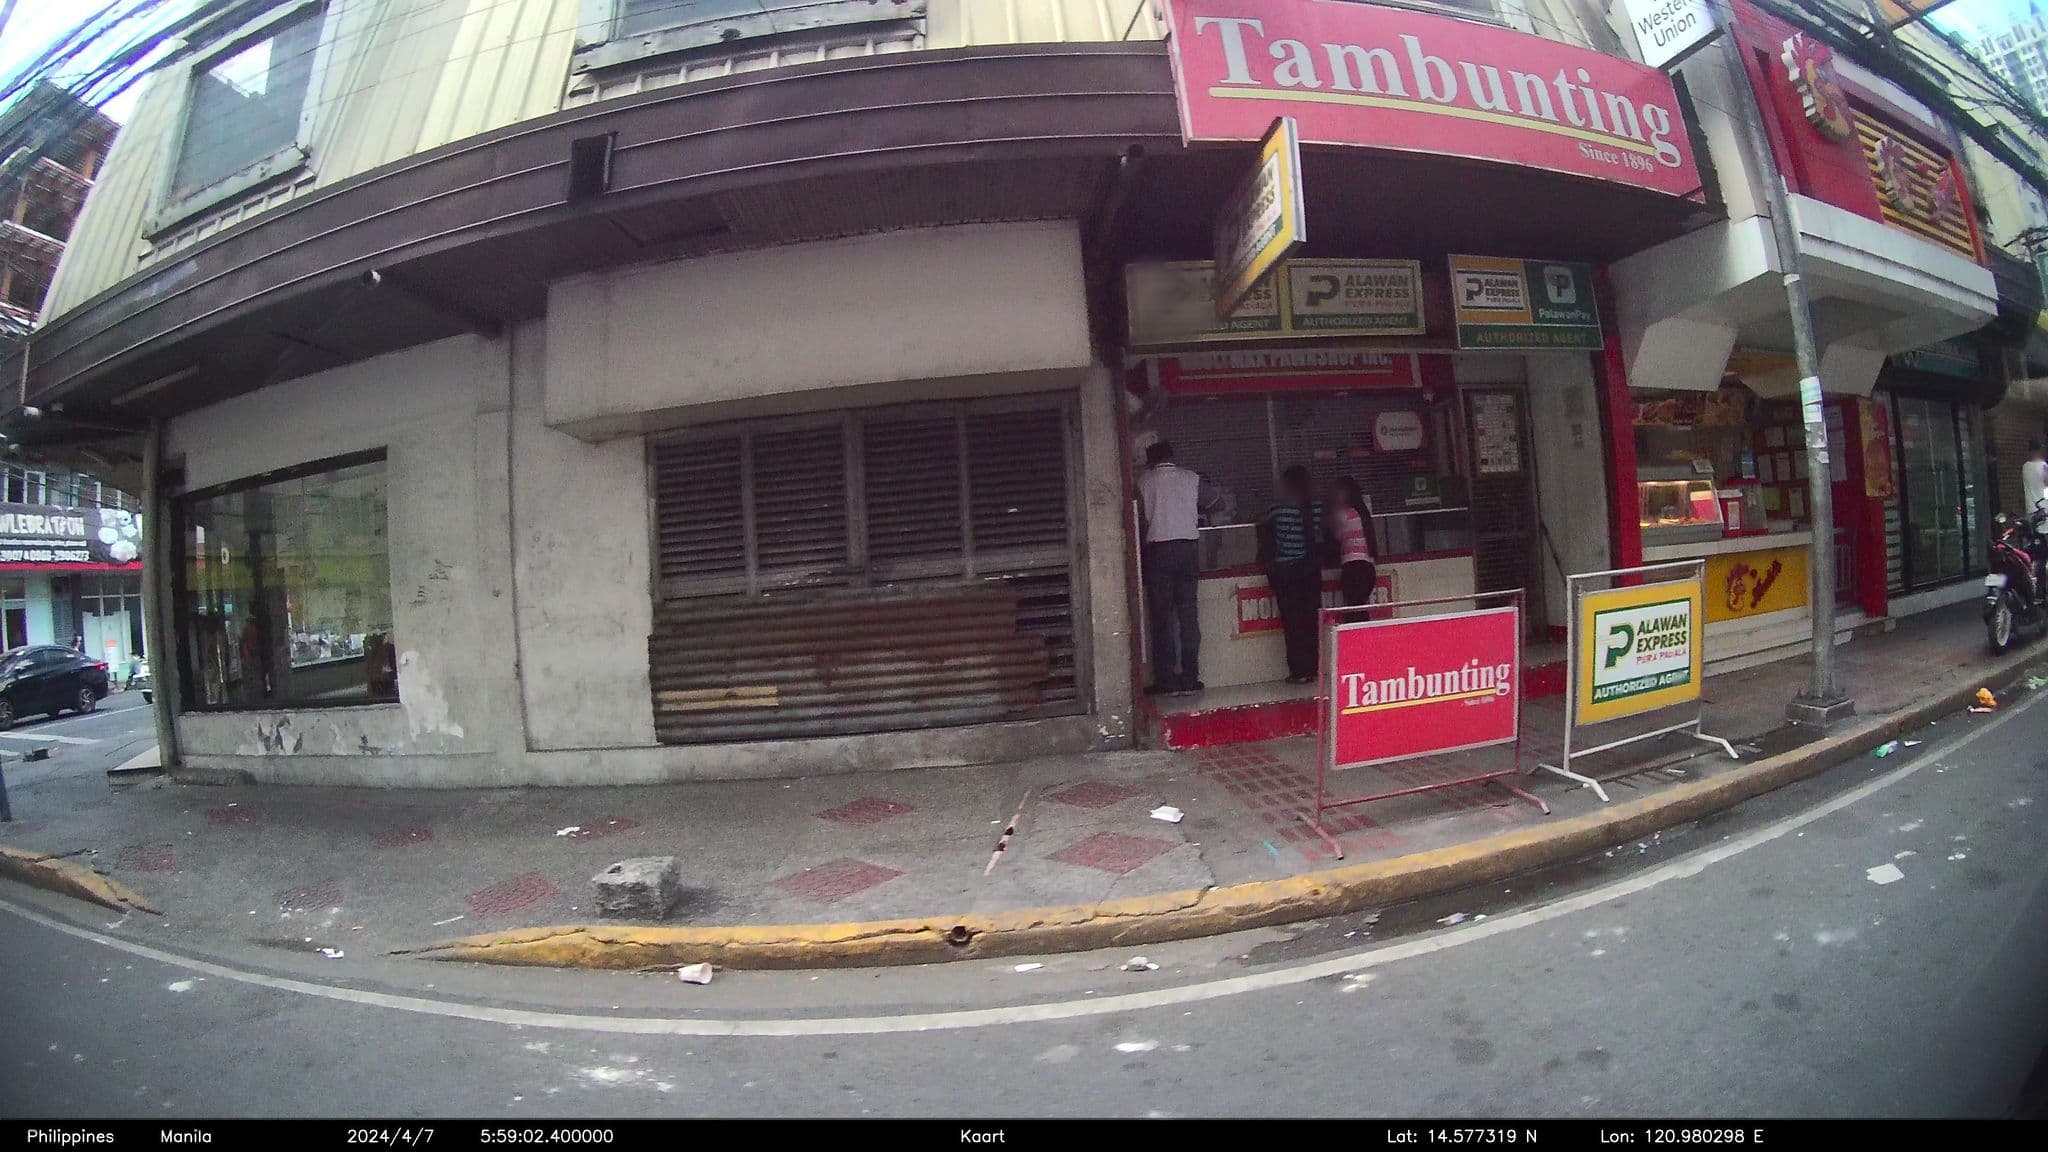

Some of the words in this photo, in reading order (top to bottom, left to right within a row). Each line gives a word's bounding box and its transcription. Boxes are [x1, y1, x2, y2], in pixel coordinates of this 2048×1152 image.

[1653, 12, 1696, 47] Union
[1196, 16, 1682, 168] Tambunting
[1579, 142, 1619, 164] Since
[1621, 151, 1654, 173] 1896
[1345, 287, 1409, 299] EXPRESS
[1636, 630, 1687, 653] EXPRESS
[1341, 659, 1511, 708] Tambunting
[1593, 678, 1657, 700] AUTHORIZED
